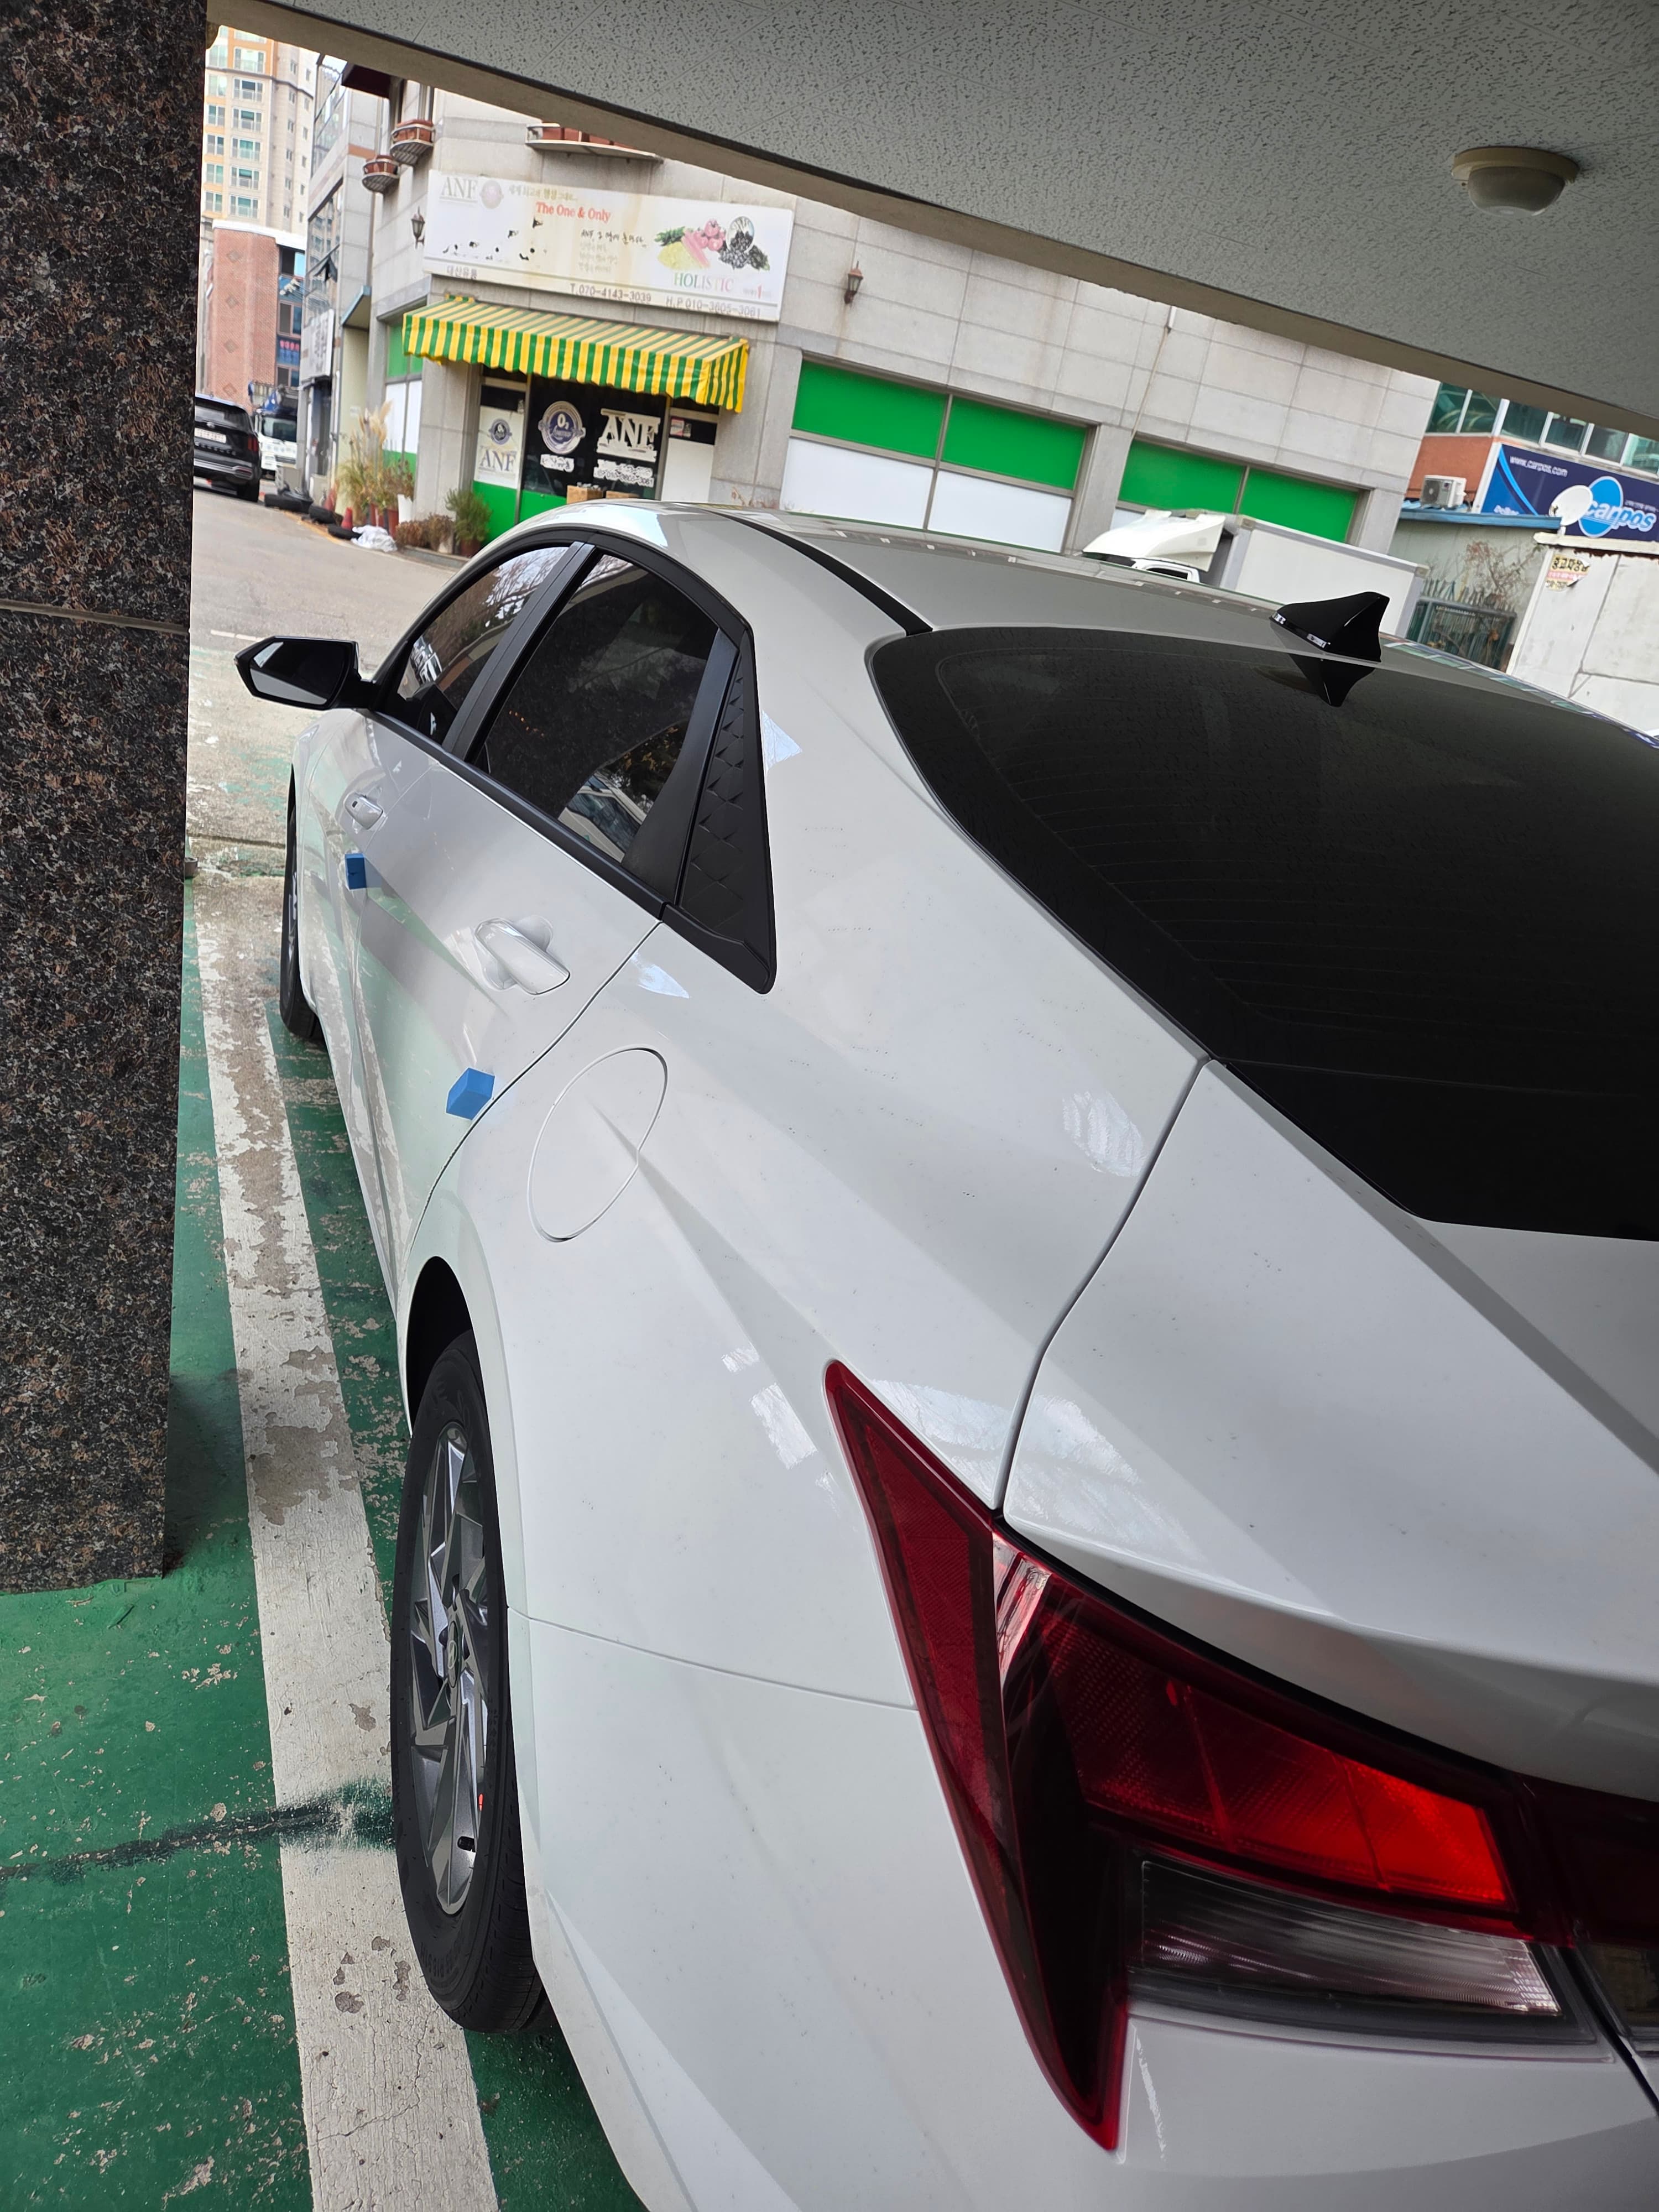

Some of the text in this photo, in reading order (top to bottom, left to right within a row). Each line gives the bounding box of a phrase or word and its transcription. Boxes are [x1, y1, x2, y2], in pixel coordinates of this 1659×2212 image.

[440, 176, 478, 200] ANF
[536, 201, 612, 224] The One & Only
[674, 273, 735, 293] HOLISTIC
[598, 408, 661, 451] ANF
[480, 445, 518, 472] ANF
[1509, 455, 1568, 478] www.carpos.com
[1588, 499, 1657, 532] carpos
